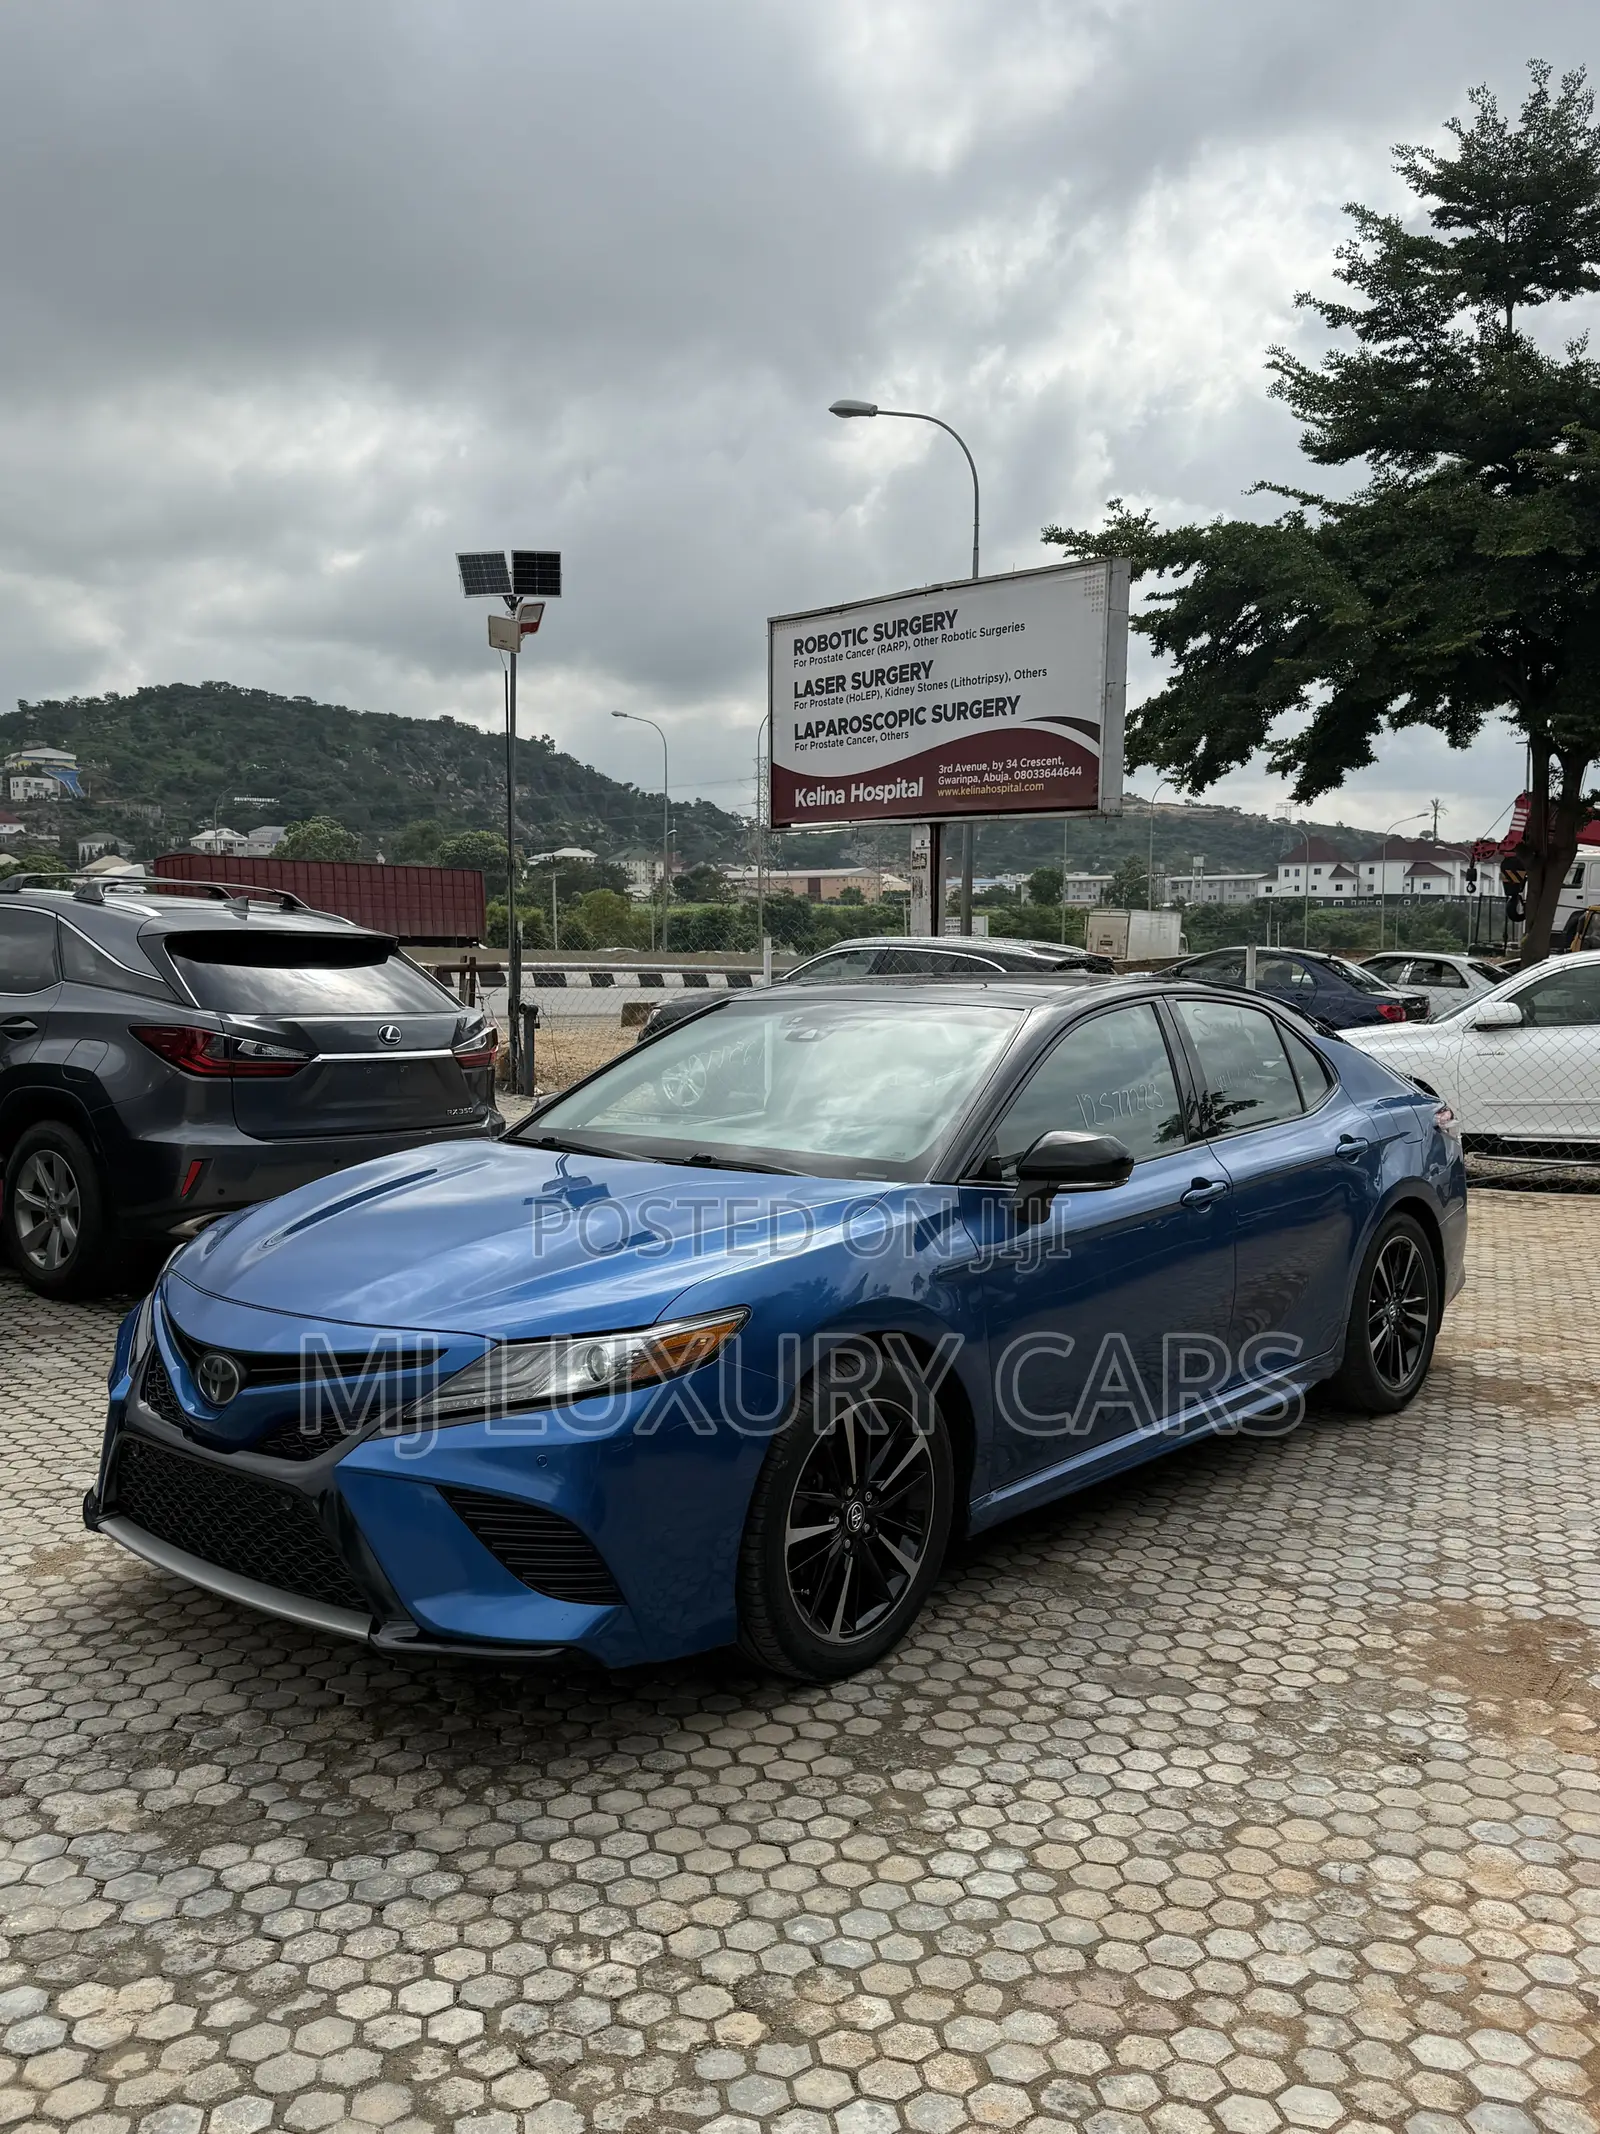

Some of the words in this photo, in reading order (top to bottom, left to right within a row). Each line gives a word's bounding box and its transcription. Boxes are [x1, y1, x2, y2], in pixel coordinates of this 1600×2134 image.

[793, 626, 869, 656] ROBOTIC
[873, 609, 959, 642] SURGERY
[793, 659, 807, 668] For
[809, 653, 844, 666] Prostate
[845, 647, 876, 660] Cancer
[877, 640, 911, 656] (RARP),
[913, 637, 939, 648] Other
[941, 629, 978, 643] Robotic
[979, 621, 1026, 637] Surgeries
[793, 674, 847, 699] LASER
[851, 660, 935, 690] SURGERY
[793, 701, 807, 710] For
[809, 696, 844, 708] Prostate
[846, 689, 883, 705] (HoLEP),
[884, 685, 915, 698] Kidney
[917, 680, 948, 693] Stones
[950, 672, 1012, 690] (Lithotripsy),
[1013, 668, 1048, 680] Others
[794, 706, 927, 740] LAPAROSCOPIC
[931, 695, 1021, 723] SURGERY
[794, 742, 808, 752] For
[809, 738, 844, 750] Prostate
[846, 735, 878, 746] Cancer,
[879, 731, 909, 742] Others
[938, 764, 953, 774] 3rd
[955, 762, 990, 773] Avenue,
[992, 760, 1004, 771] by
[1006, 759, 1018, 769] 34
[1020, 756, 1065, 768] Crescent,
[938, 774, 981, 786] Gwarinpa,
[983, 771, 1012, 783] Abuja.
[1014, 766, 1082, 780] 08033644644
[795, 784, 845, 808] Kelina
[850, 776, 924, 804] Hospital
[937, 782, 1045, 797] www.kelinahospital.com
